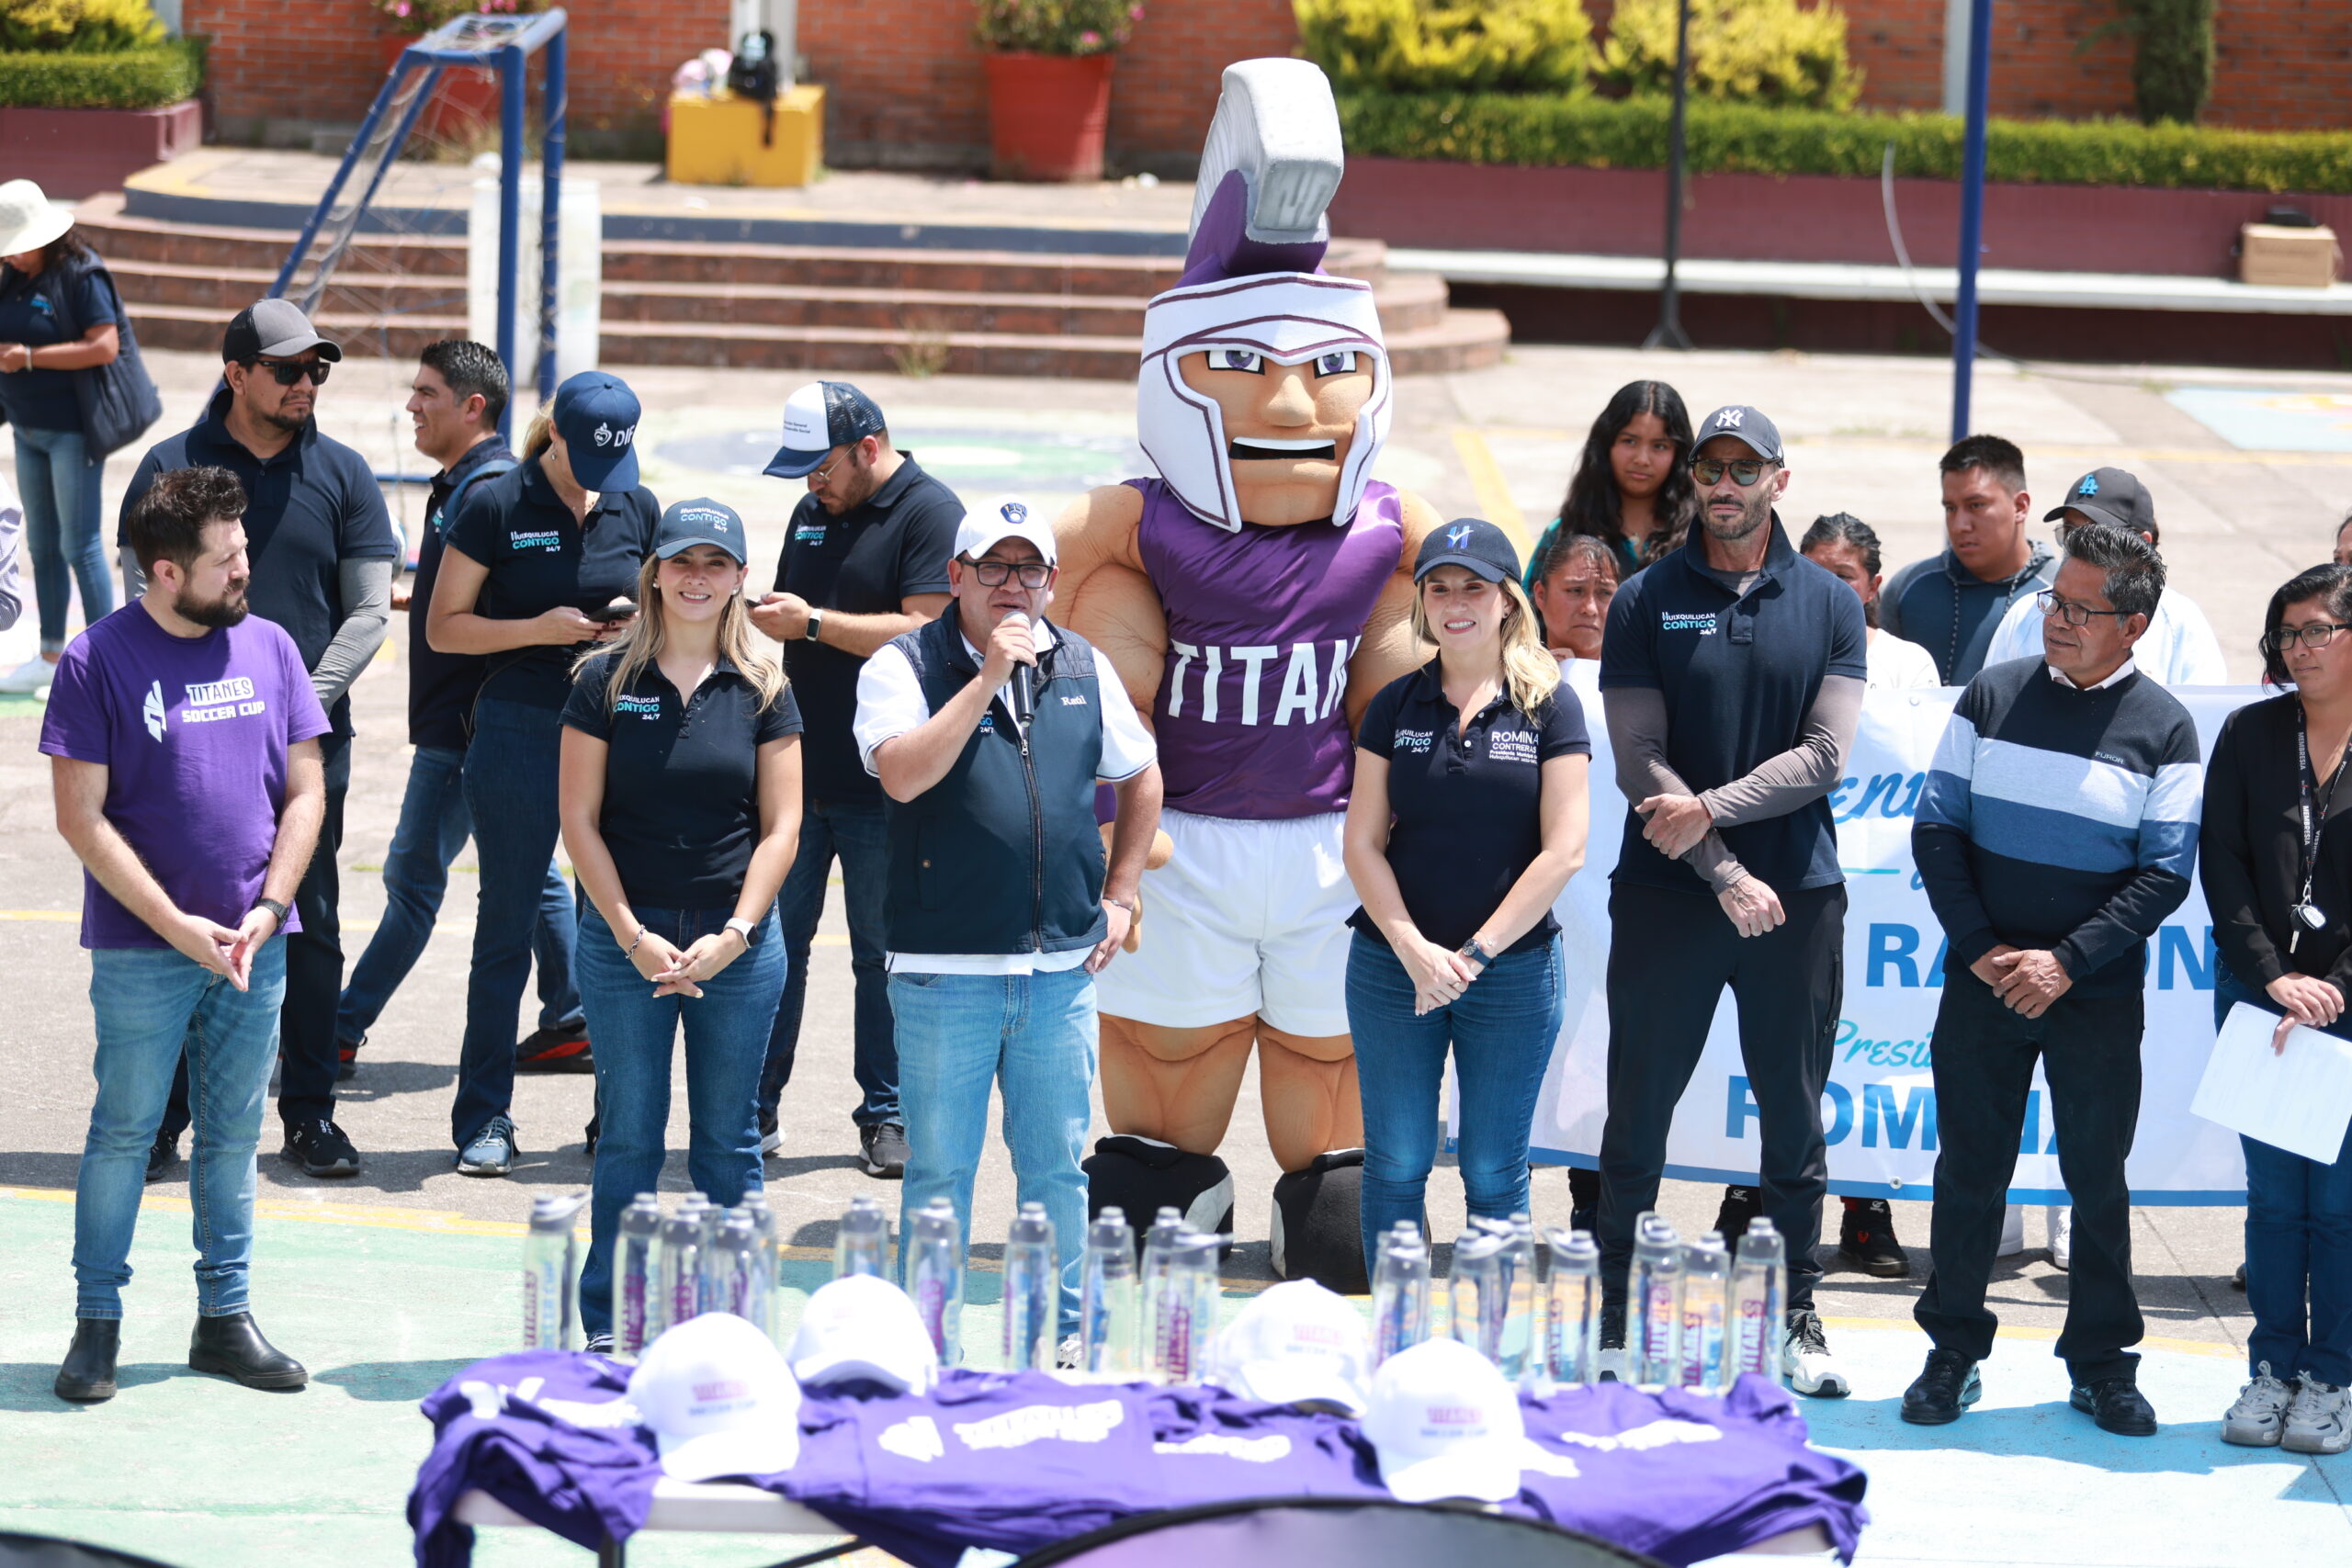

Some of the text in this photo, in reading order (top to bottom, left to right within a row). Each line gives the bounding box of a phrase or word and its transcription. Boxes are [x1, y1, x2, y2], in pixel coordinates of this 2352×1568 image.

[614, 424, 635, 447] DIF
[681, 513, 728, 526] CONTIGO
[513, 537, 560, 549] CONTIGO
[1663, 619, 1716, 630] CONTIGO
[188, 679, 252, 703] TITANES
[181, 701, 266, 723] SOCCER CUP
[1491, 730, 1539, 745] ROMINA
[1492, 742, 1537, 754] CONTRERAS
[2095, 750, 2124, 764] FUROR
[2302, 806, 2311, 846] MEMBRESIA
